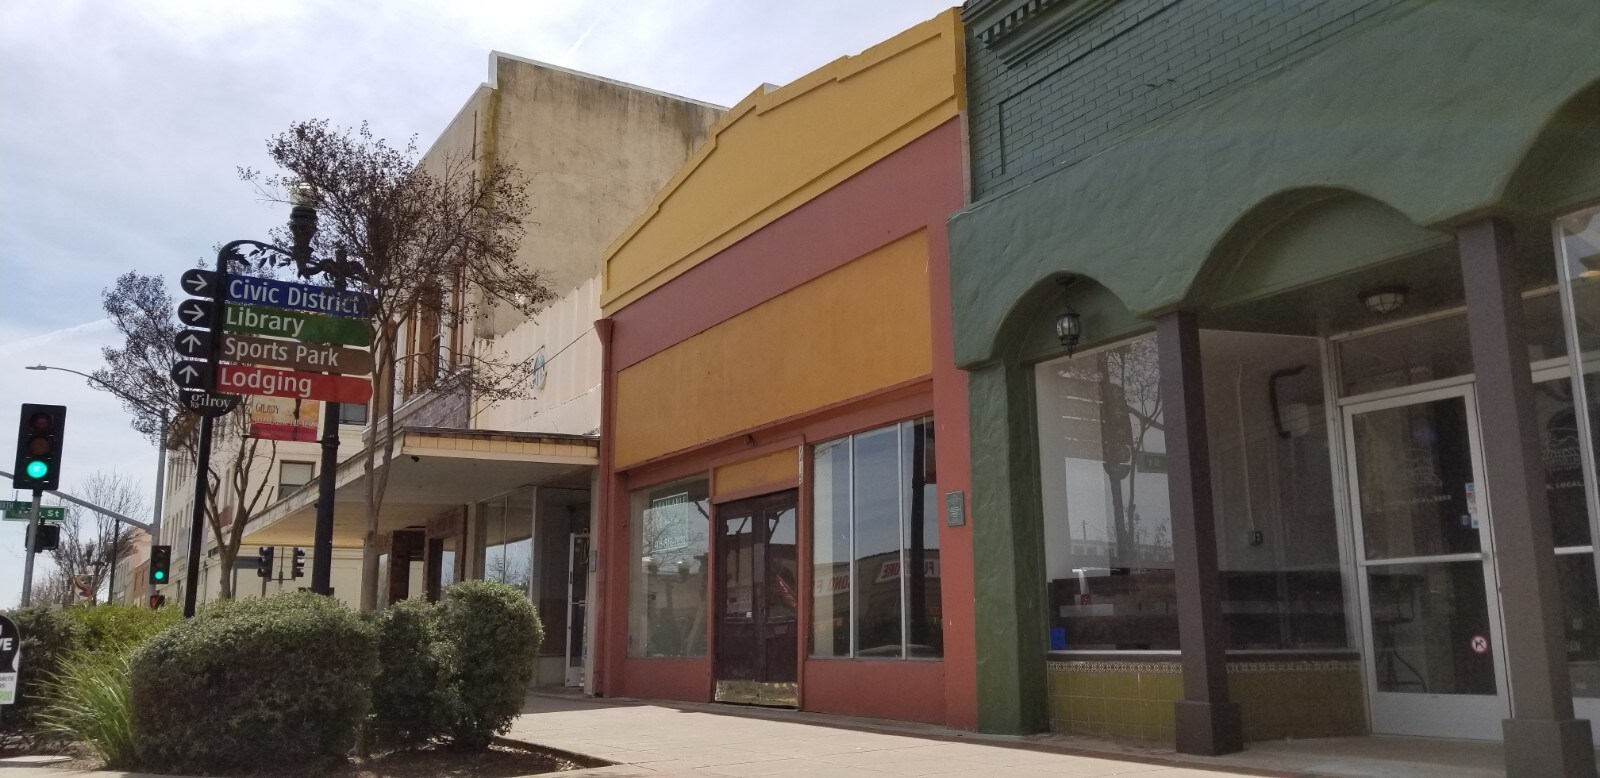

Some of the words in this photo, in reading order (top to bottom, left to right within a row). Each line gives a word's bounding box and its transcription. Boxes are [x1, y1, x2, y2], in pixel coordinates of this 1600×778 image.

[229, 279, 279, 304] Civic
[287, 285, 359, 314] District
[226, 306, 305, 338] Library
[224, 337, 288, 362] Sports
[295, 345, 339, 367] Park
[220, 367, 312, 398] Lodging
[190, 393, 231, 412] gilroy
[256, 401, 279, 415] GILROY
[47, 509, 60, 518] St
